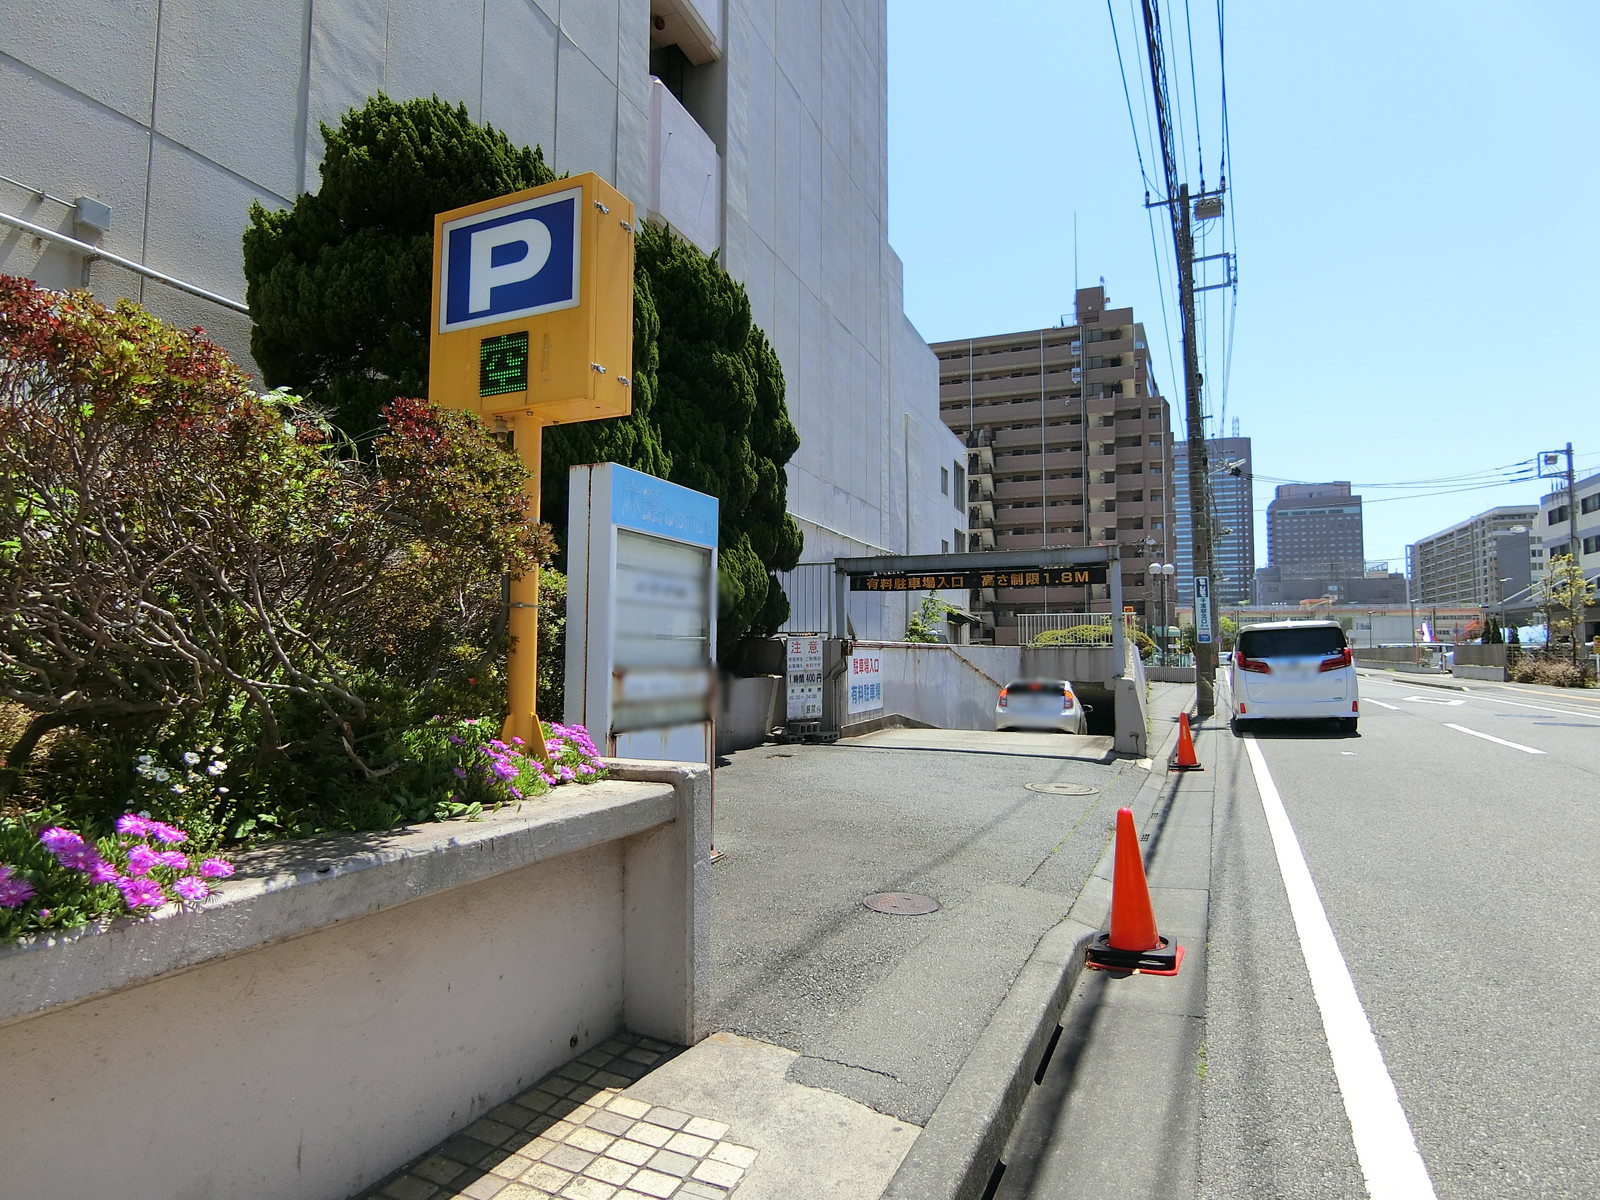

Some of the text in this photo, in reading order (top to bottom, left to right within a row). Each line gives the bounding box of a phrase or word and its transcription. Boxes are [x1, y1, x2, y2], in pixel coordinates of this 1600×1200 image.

[468, 218, 552, 315] P
[866, 570, 1089, 591] 有料駐車場入口 高さ制限1.8M
[791, 640, 819, 654] 注意
[853, 658, 879, 675] 駐車場入口
[851, 682, 881, 704] 有料駐車場
